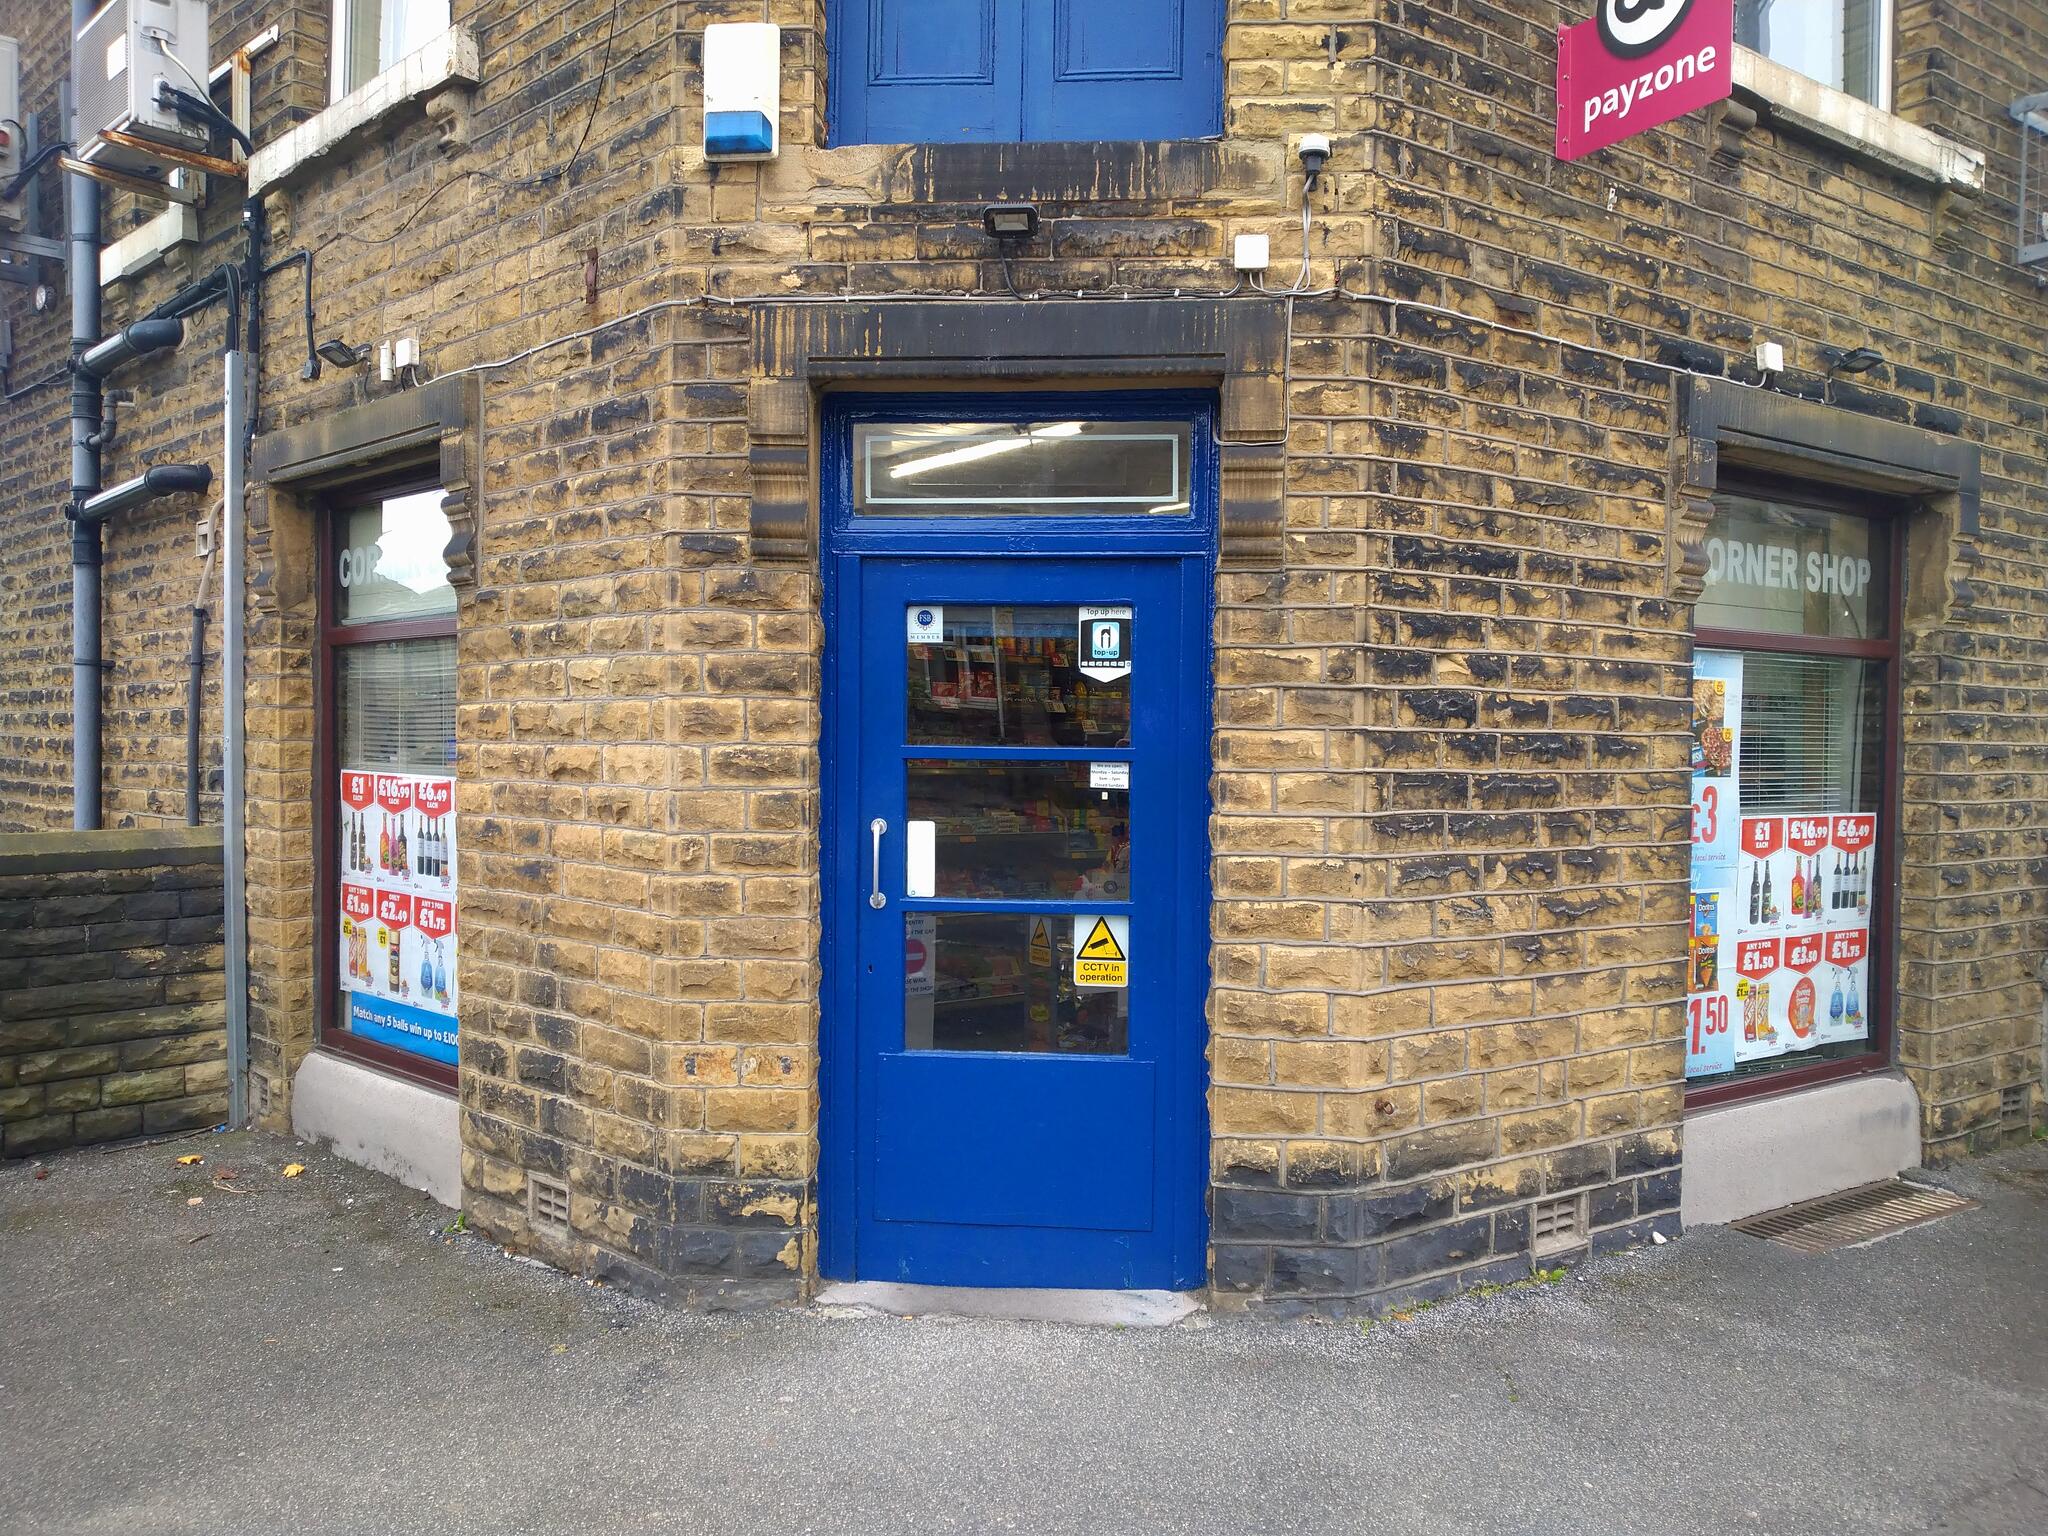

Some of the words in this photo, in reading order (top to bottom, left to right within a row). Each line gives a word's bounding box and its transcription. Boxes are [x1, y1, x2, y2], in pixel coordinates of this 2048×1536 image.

[1584, 45, 1716, 133] payzone
[1702, 537, 1798, 590] ORNER
[1806, 551, 1872, 597] SHOP
[919, 614, 932, 622] FSB
[1087, 608, 1099, 616] Top
[352, 776, 364, 795] £1
[379, 778, 410, 798] £16.99
[419, 781, 447, 802] £6.49
[427, 801, 439, 809] EACH
[1755, 822, 1770, 840] £1
[1790, 820, 1828, 840] £16.99
[1837, 819, 1870, 838] £6.49
[1804, 839, 1816, 847] EACH
[1847, 837, 1860, 845] EACH
[1709, 852, 1726, 861] service
[346, 894, 369, 915] £1.50
[389, 894, 400, 902] ONLY
[421, 899, 431, 907] ANY
[435, 902, 444, 910] FOR
[381, 900, 407, 922] £2.49
[419, 908, 446, 931] £1.75
[1801, 936, 1812, 945] ONLY
[1834, 932, 1845, 940] ANY
[1850, 931, 1859, 939] FOR
[1746, 942, 1758, 950] ANY
[1762, 941, 1771, 949] FOR
[1832, 940, 1860, 959] £1.75
[1743, 951, 1774, 971] £1.50
[1791, 946, 1818, 966] £3.50
[1083, 963, 1109, 972] CCTV
[1111, 963, 1120, 972] in
[1080, 973, 1123, 982] operation
[353, 1005, 373, 1020] Match
[373, 1013, 386, 1027] any
[387, 1015, 392, 1027] 5
[392, 1016, 409, 1032] balls
[409, 1022, 422, 1036] win
[423, 1027, 433, 1040] up
[433, 1029, 442, 1041] to
[1684, 994, 1728, 1056] 1.50
[1703, 1061, 1722, 1072] service
